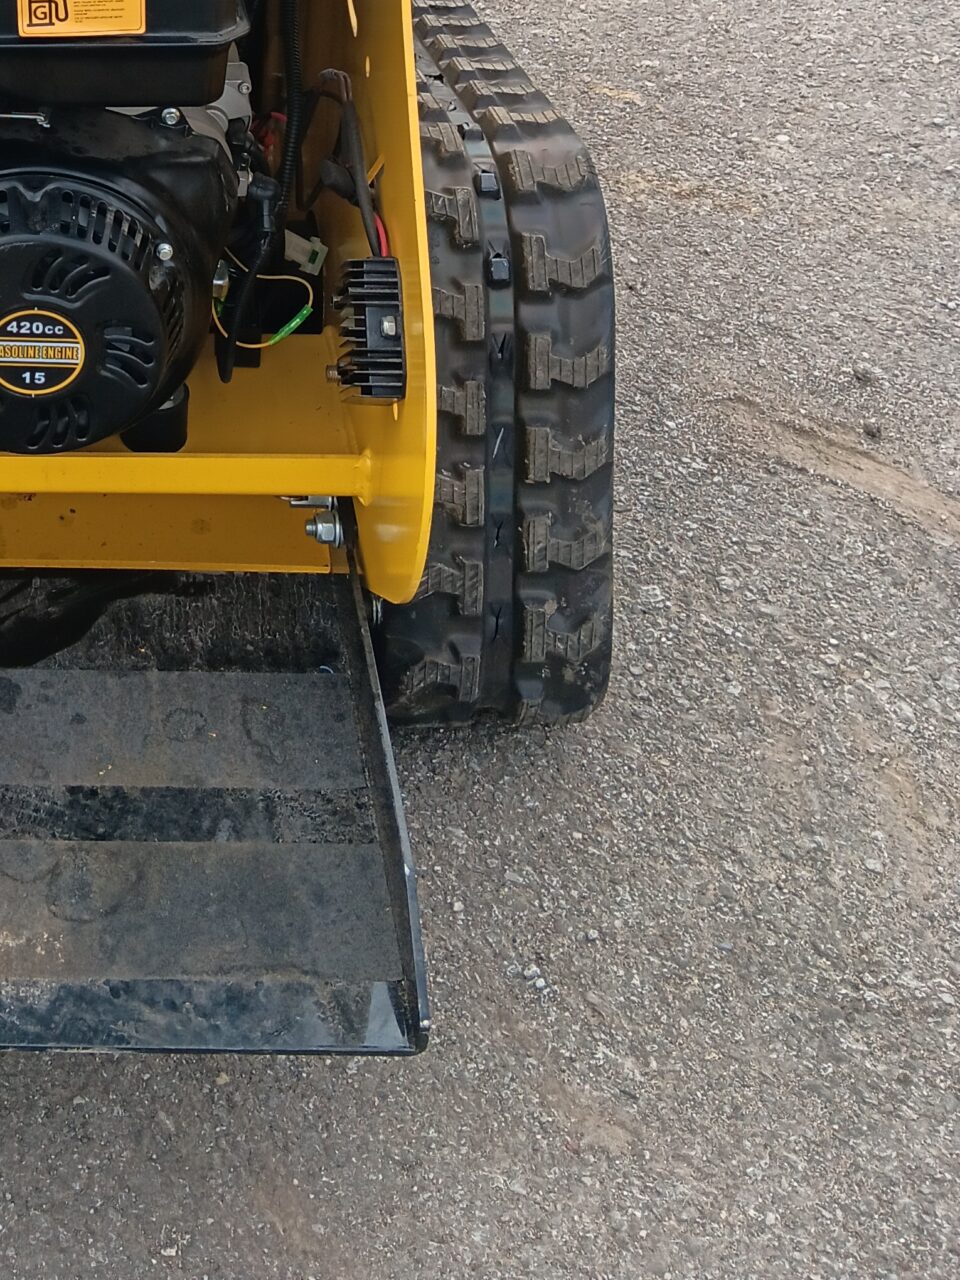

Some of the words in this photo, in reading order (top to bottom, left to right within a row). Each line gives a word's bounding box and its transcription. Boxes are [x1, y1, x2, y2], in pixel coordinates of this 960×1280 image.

[33, 5, 48, 21] G
[6, 321, 64, 335] 420cc
[41, 345, 79, 361] ENGINE
[21, 371, 46, 384] 15
